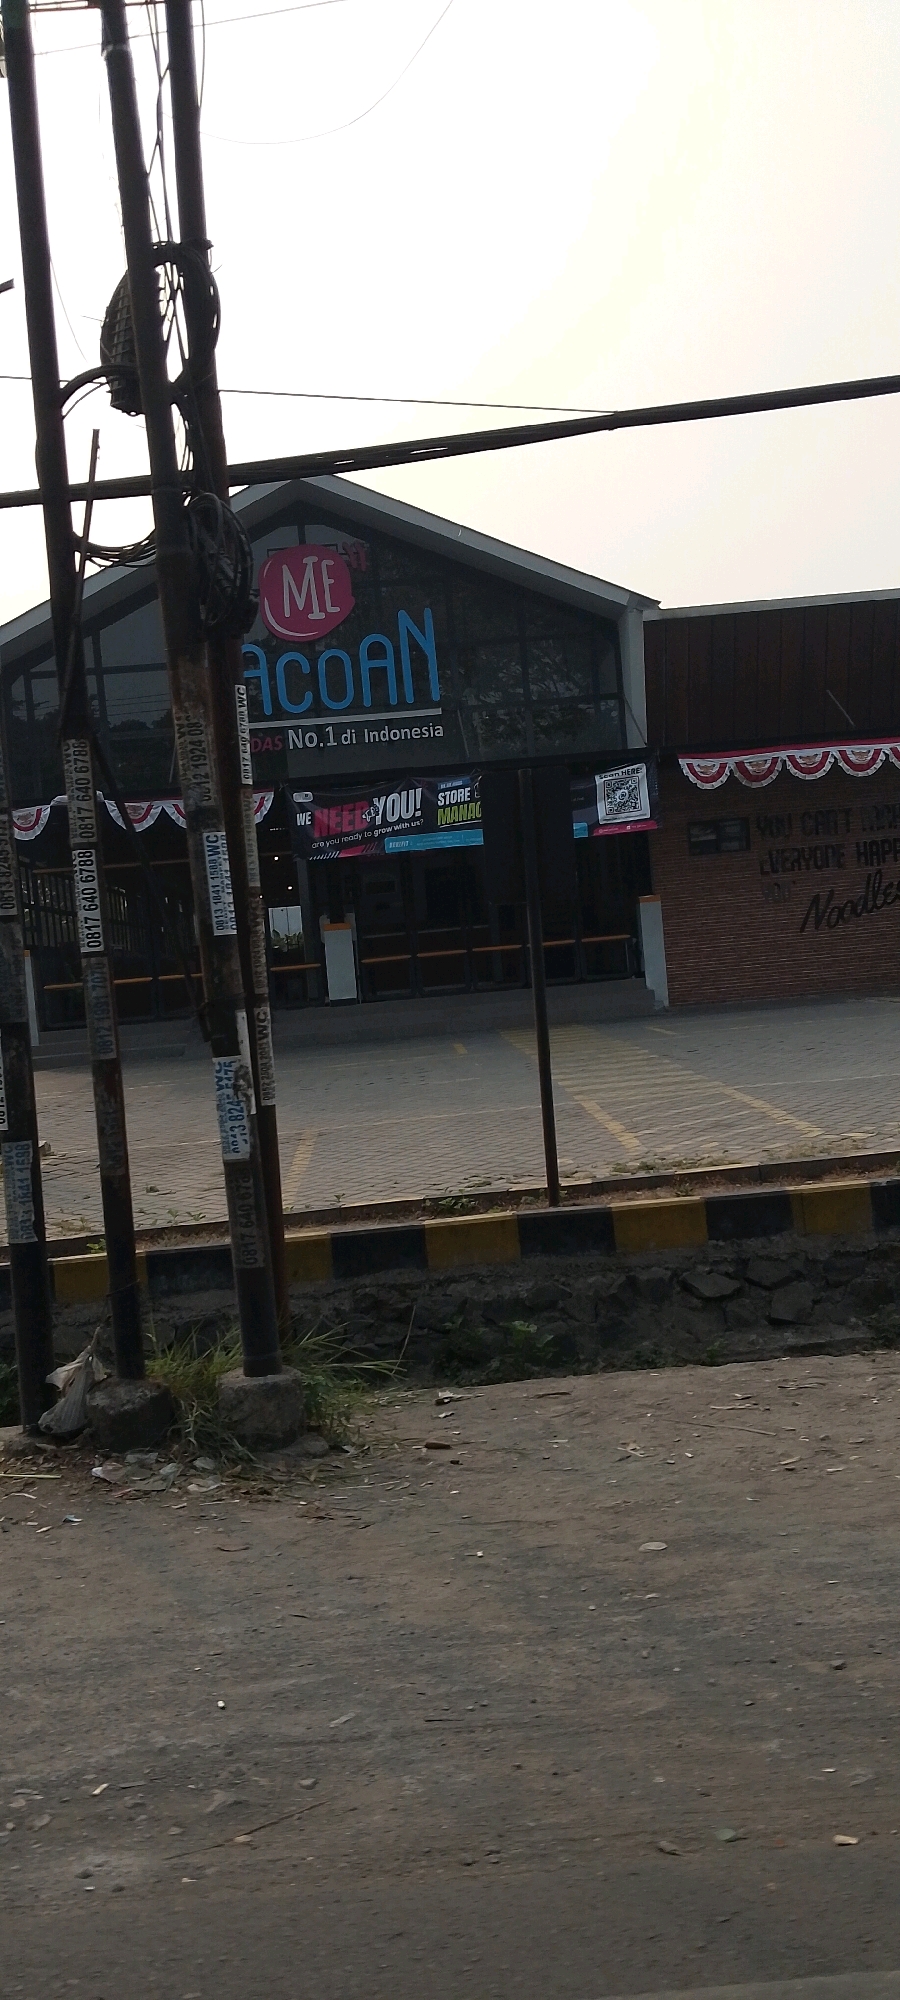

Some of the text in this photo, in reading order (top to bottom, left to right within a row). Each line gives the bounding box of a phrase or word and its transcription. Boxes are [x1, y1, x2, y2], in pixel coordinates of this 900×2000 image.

[241, 607, 441, 716] ACOAN
[237, 687, 247, 709] WC
[249, 722, 444, 753] DAS No.1 di Indonesia
[187, 739, 208, 770] 1924
[71, 740, 95, 840] 0817 640 6788
[599, 771, 621, 780] Scan
[437, 786, 471, 807] STORE
[296, 787, 423, 838] WE NEED YOU!
[437, 801, 482, 826] MANAG
[205, 834, 221, 858] WC
[312, 840, 325, 849] are
[326, 839, 340, 848] you
[341, 832, 363, 843] ready
[373, 826, 394, 838] grow
[393, 821, 410, 831] with
[411, 819, 424, 827] us?
[78, 850, 96, 884] 6788
[856, 837, 900, 867] HAPP
[81, 887, 99, 912] 640
[84, 916, 102, 949] 0817
[214, 908, 226, 931] 0813
[255, 1011, 269, 1041] WC
[237, 1203, 256, 1229] 640
[239, 1233, 258, 1267] 0817
